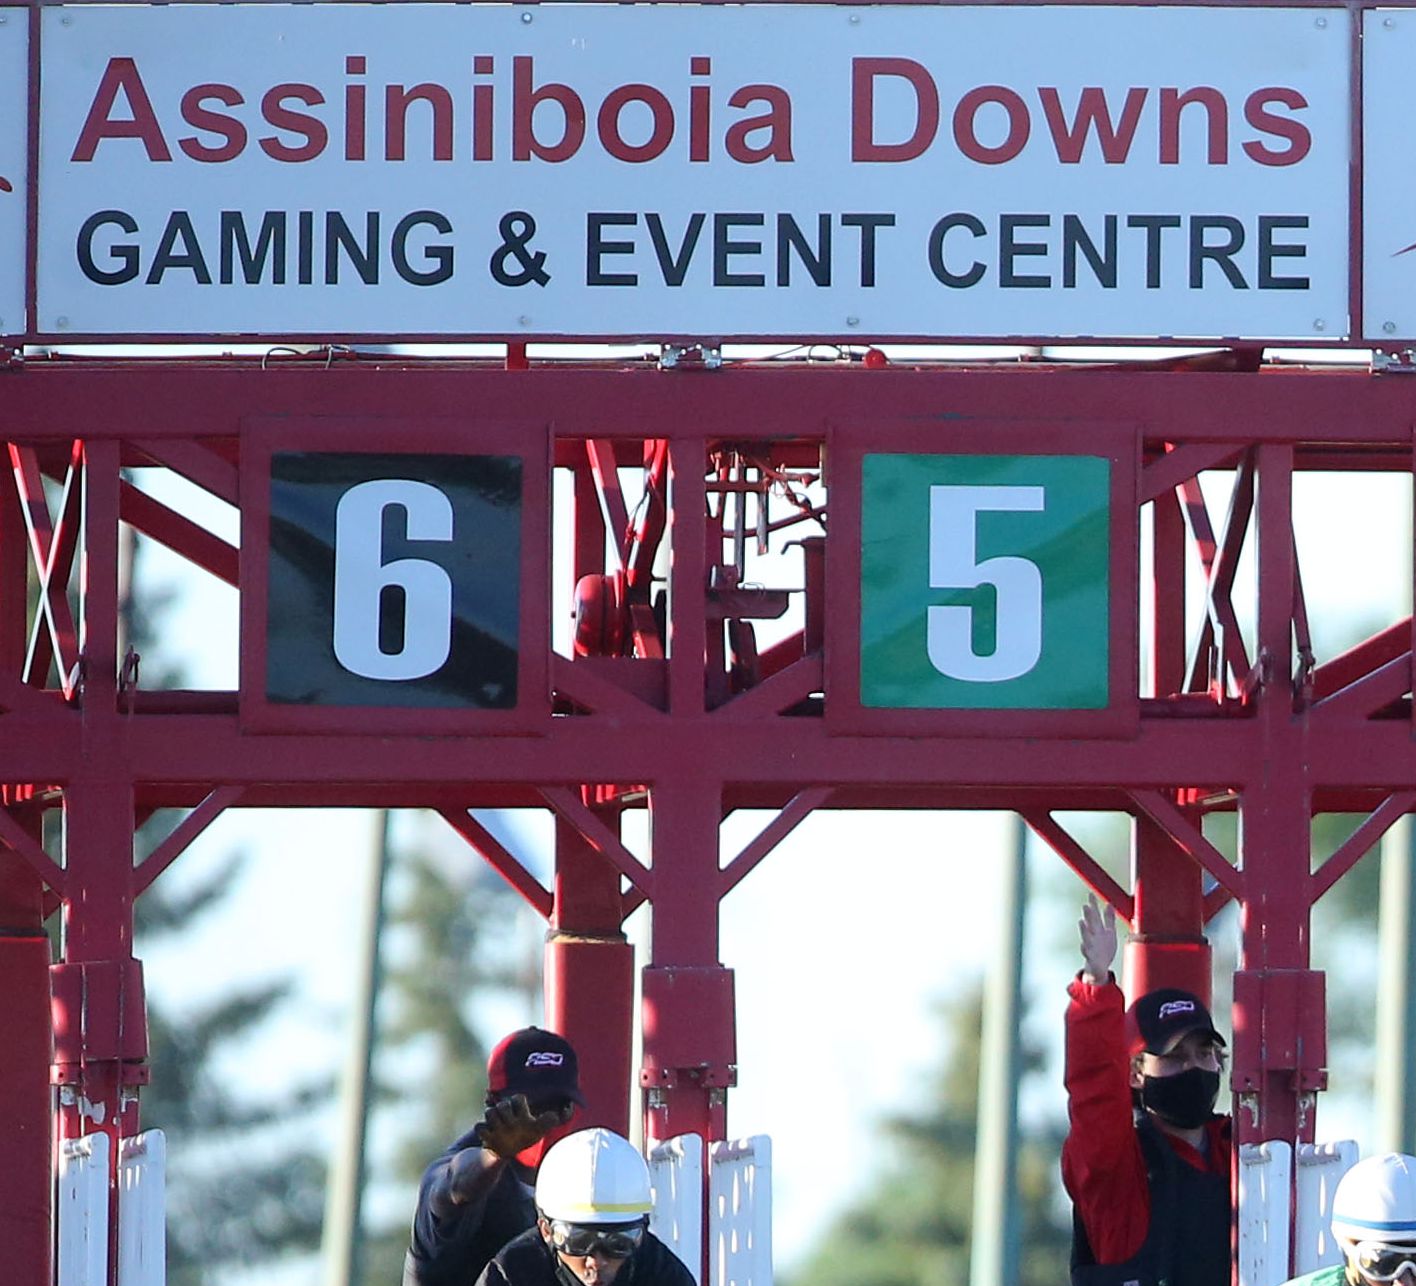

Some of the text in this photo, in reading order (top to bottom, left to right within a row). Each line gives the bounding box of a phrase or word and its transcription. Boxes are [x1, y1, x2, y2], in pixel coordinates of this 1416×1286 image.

[70, 56, 1312, 167] Assiniboia Downs
[76, 209, 1310, 291] GAMING & EVENT CENTRE
[333, 479, 455, 681] 6
[927, 485, 1044, 682] 5
